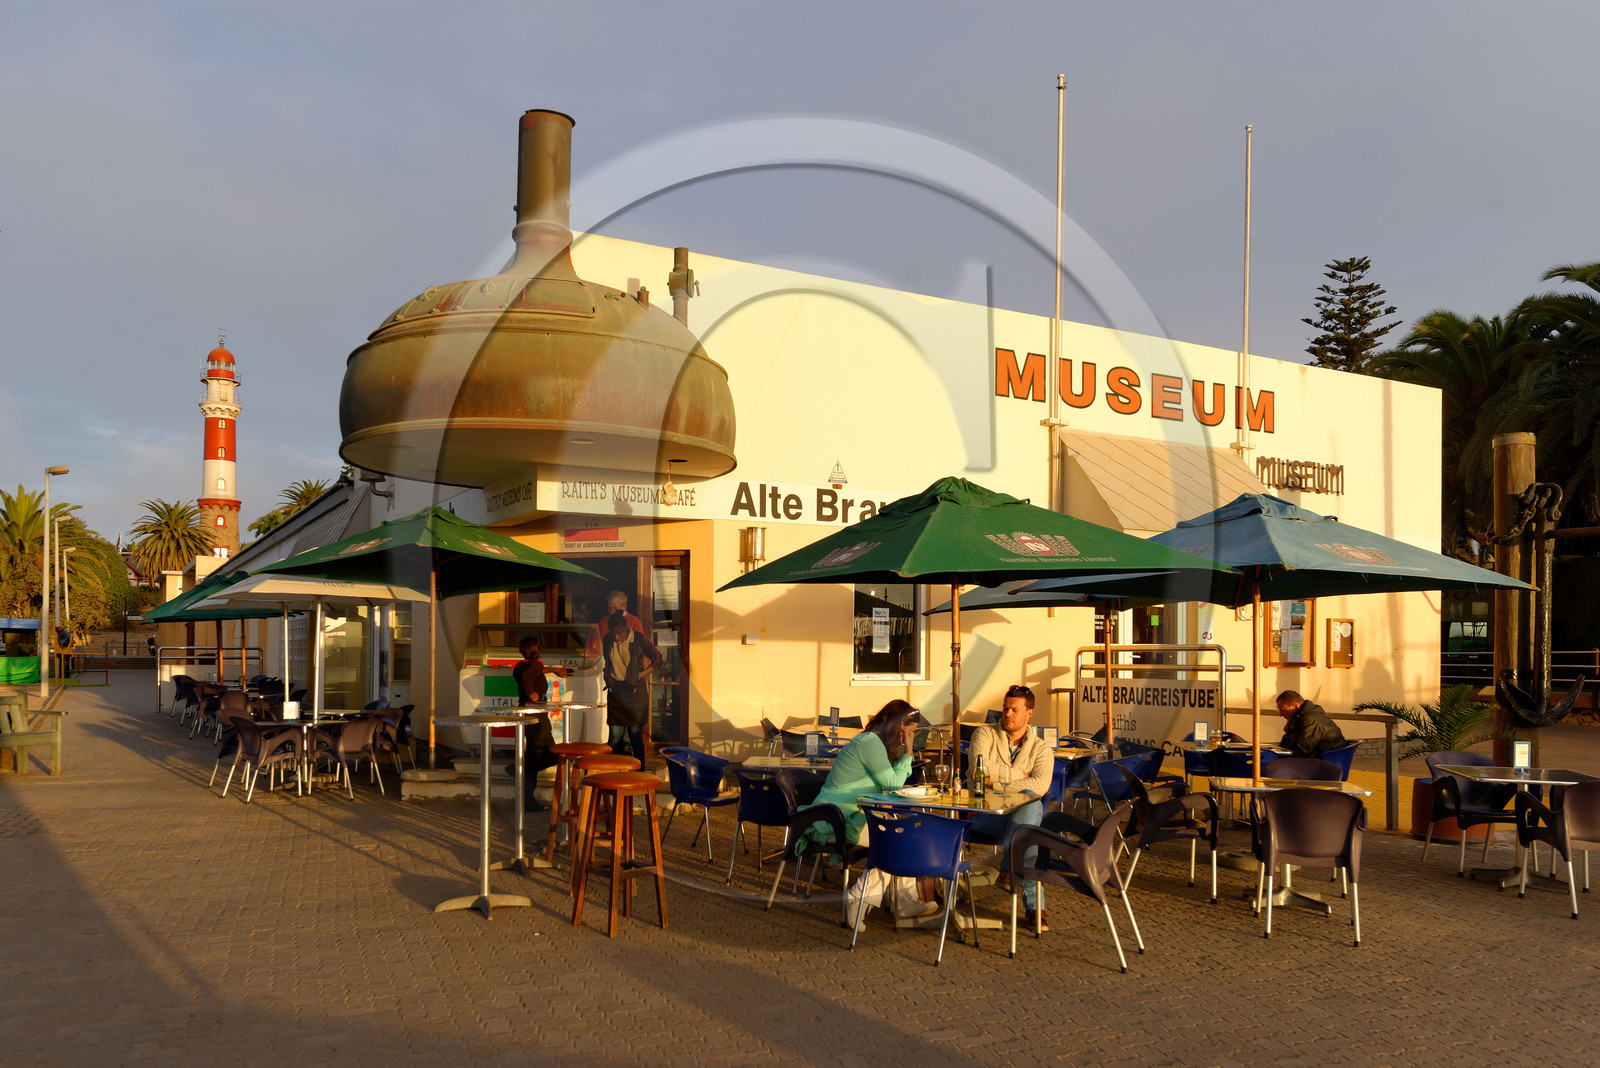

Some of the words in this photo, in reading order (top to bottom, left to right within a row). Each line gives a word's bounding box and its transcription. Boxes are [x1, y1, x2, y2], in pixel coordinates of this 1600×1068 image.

[995, 347, 1275, 434] MUSEUM
[561, 481, 607, 500] RAITH'S
[673, 488, 696, 506] AFÉ
[1259, 456, 1344, 496] MUSEUM
[730, 482, 803, 520] Alte
